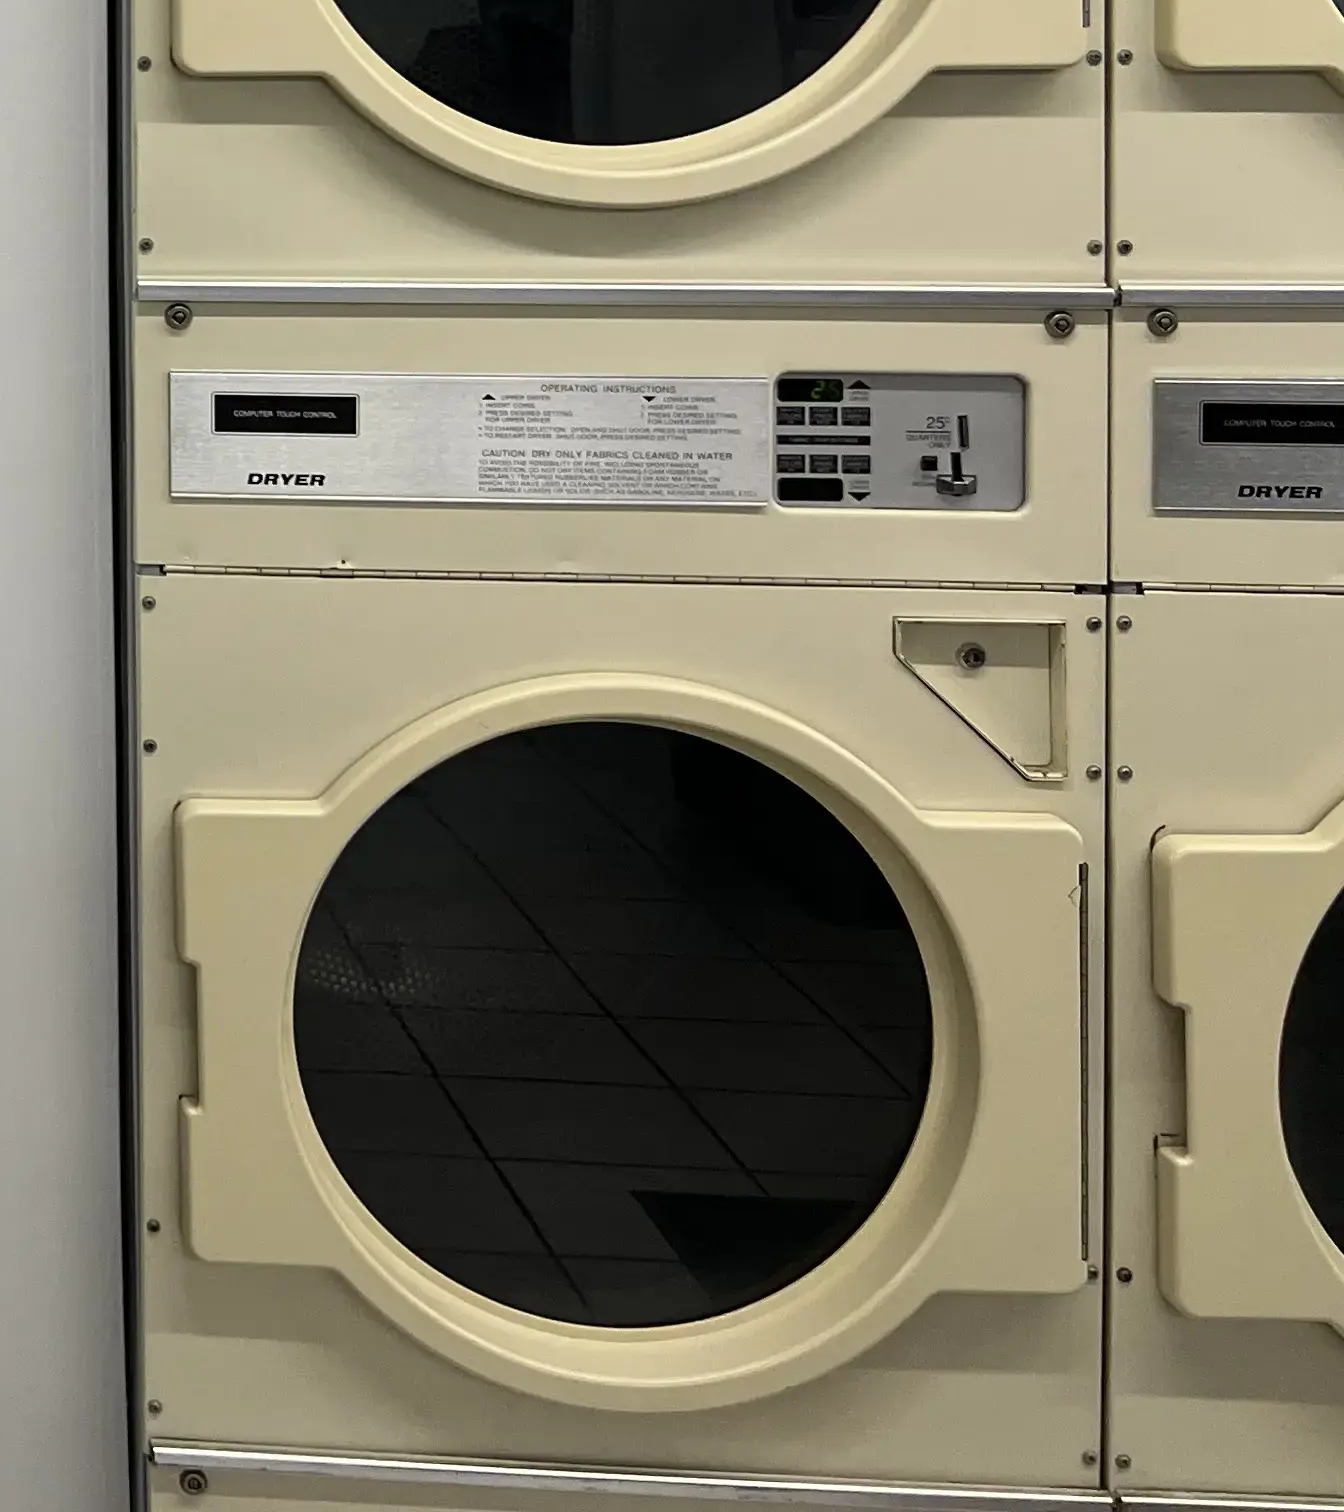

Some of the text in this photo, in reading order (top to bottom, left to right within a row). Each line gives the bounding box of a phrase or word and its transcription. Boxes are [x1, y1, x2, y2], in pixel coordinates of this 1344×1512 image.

[540, 384, 676, 394] OPERATING INSTRUCTIONS
[276, 410, 301, 418] TOUCH
[303, 411, 337, 419] CONTROL
[481, 449, 733, 461] CAUTION DRY ONLY FABRICS CLEANED IN WATER
[247, 473, 326, 486] DRYER
[1238, 485, 1323, 499] DRYER
